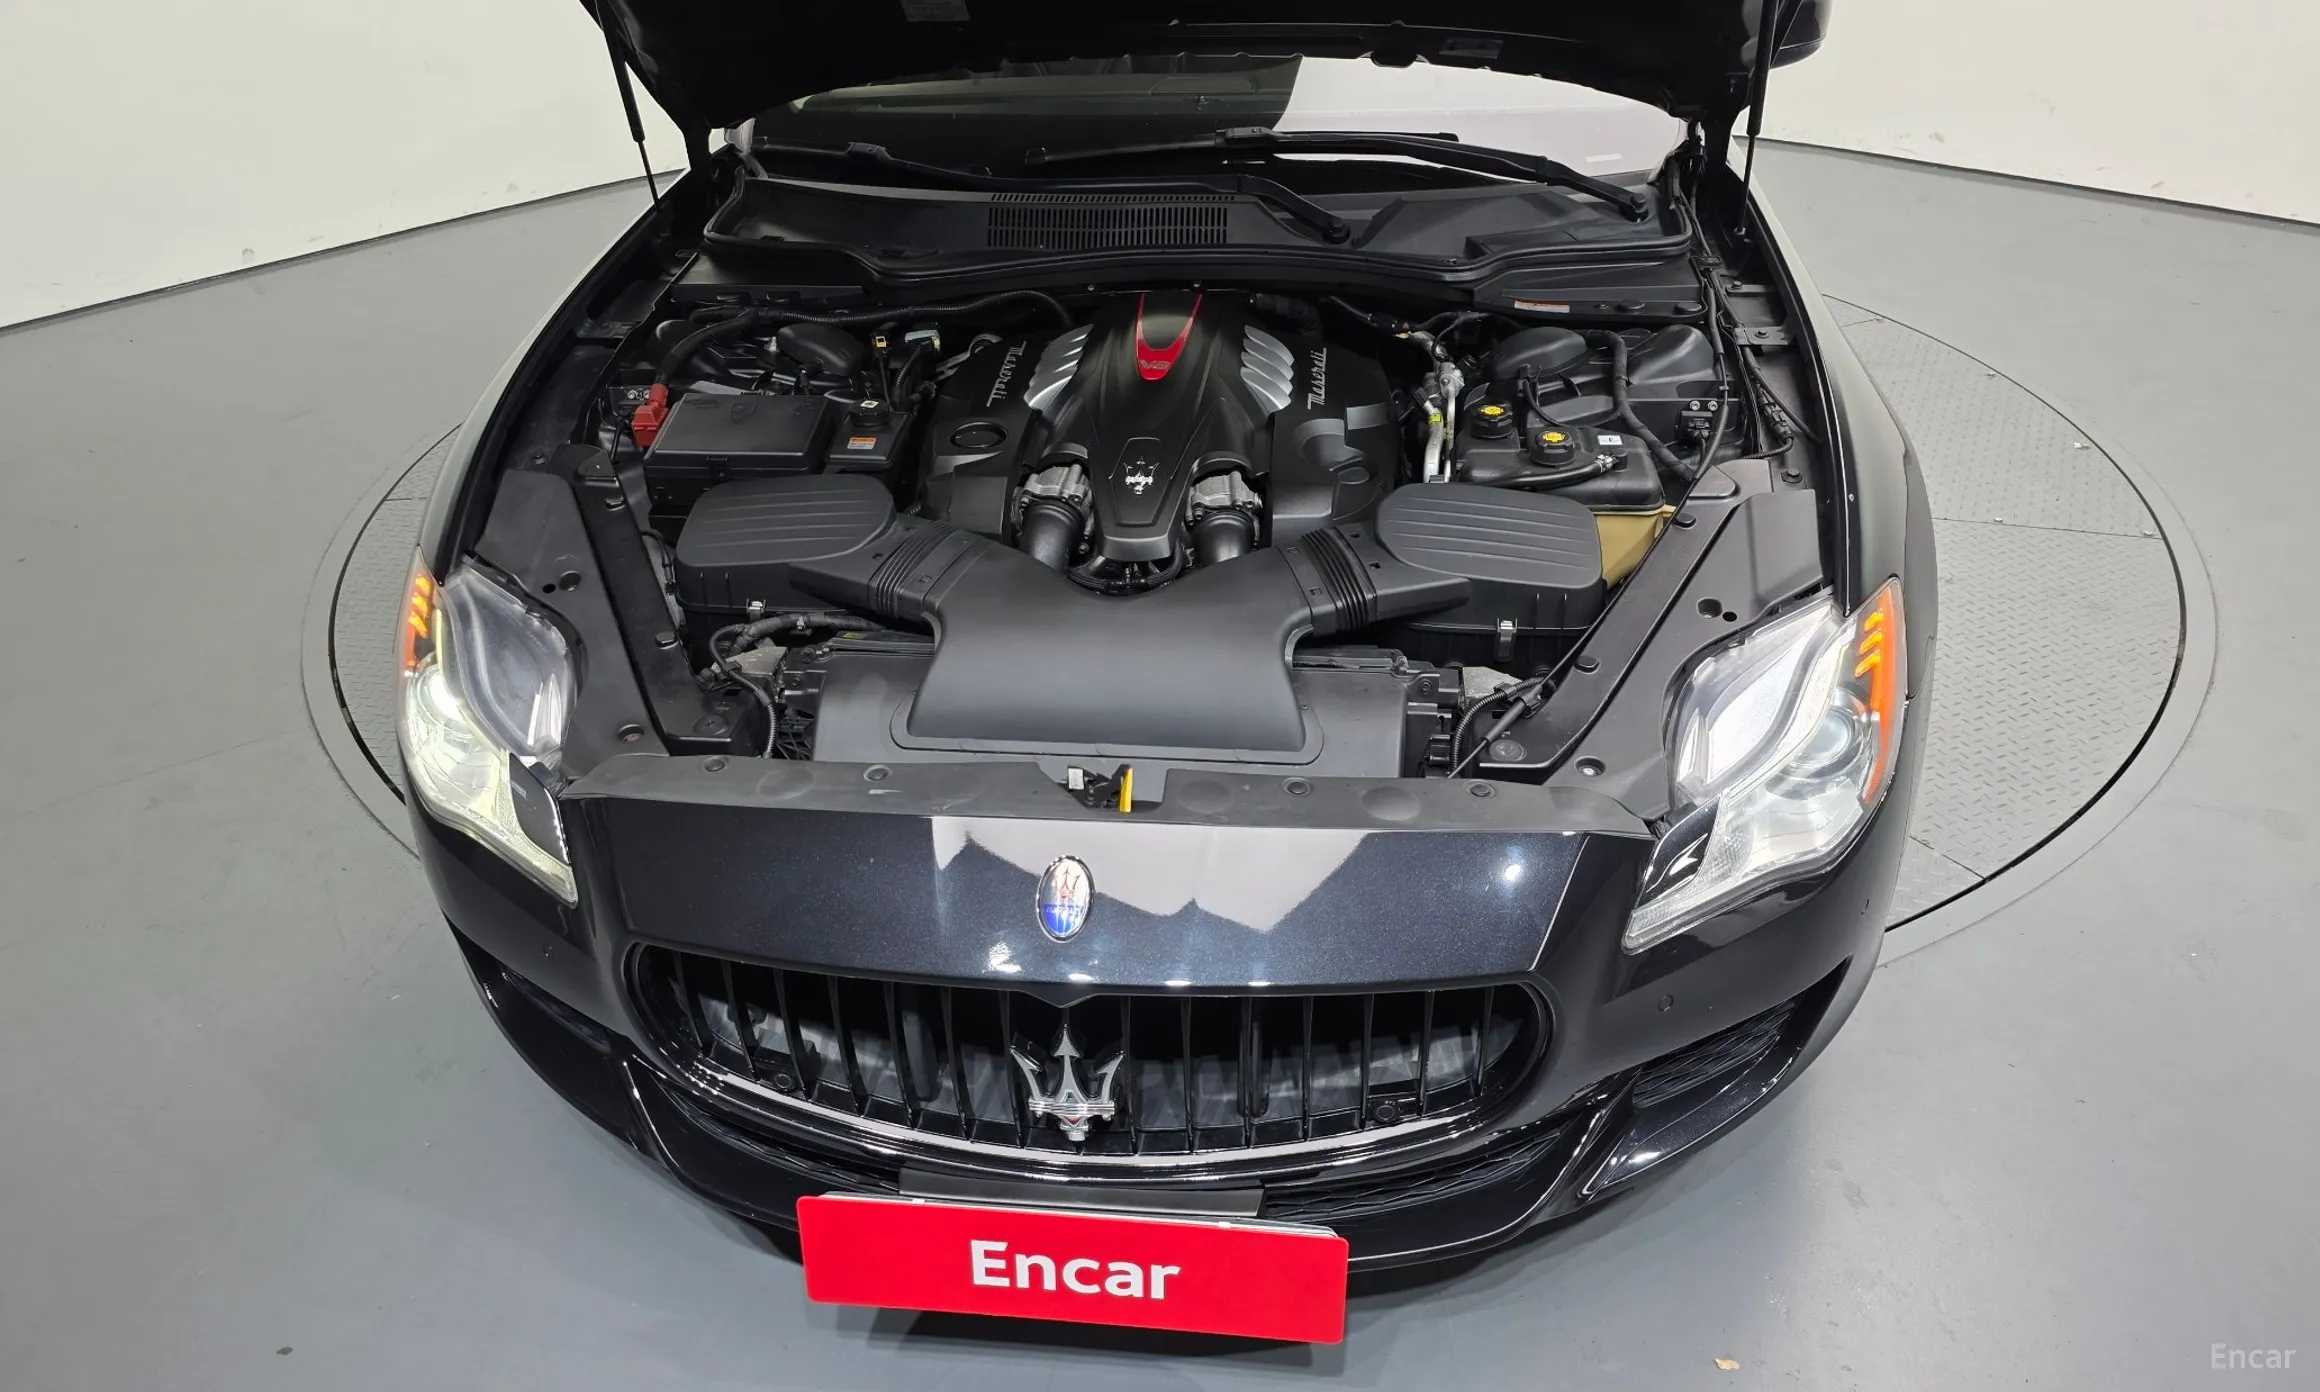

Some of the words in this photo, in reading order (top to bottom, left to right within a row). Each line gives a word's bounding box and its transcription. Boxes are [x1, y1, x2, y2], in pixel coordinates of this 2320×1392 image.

[986, 341, 1027, 407] Maserati
[1307, 347, 1327, 410] Maserati
[970, 1239, 1181, 1300] Encar
